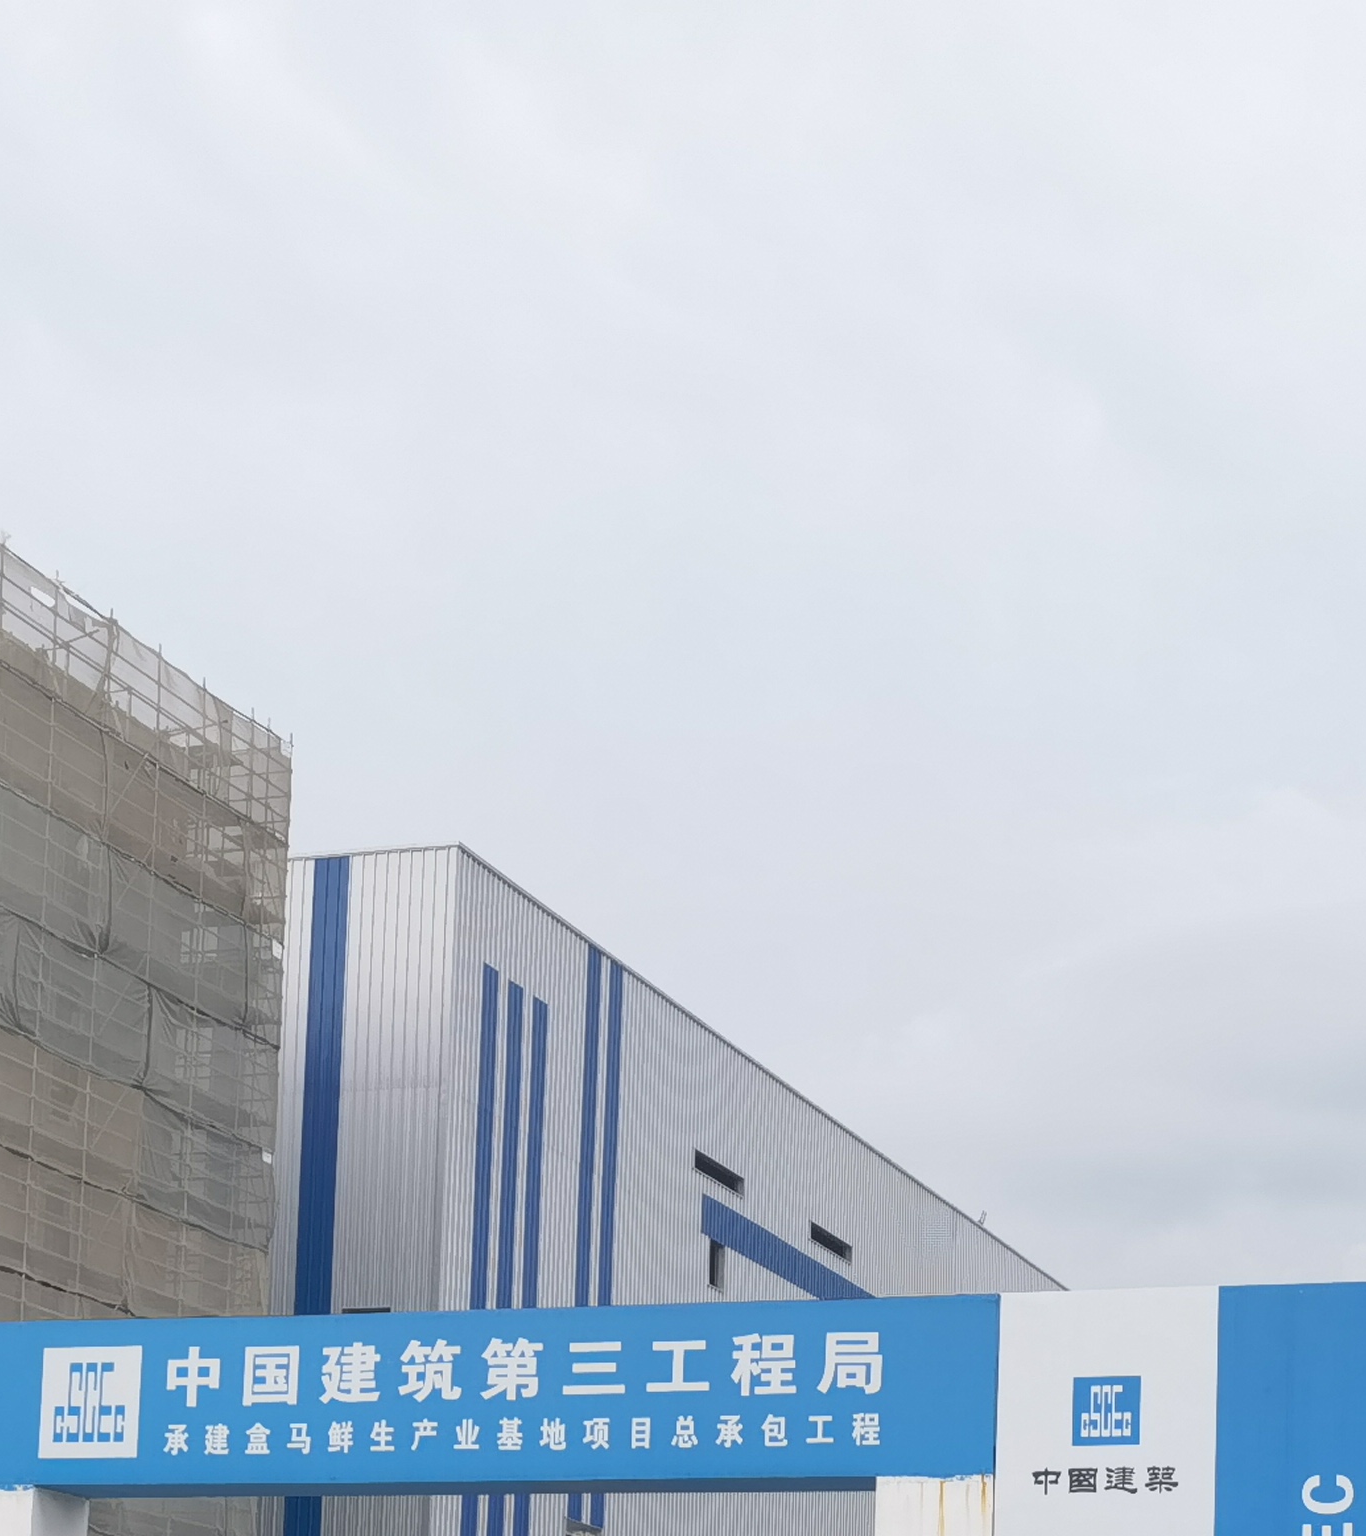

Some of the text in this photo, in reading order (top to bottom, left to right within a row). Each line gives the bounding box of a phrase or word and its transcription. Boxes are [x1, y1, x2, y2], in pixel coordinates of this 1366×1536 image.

[165, 1331, 883, 1408] 中国建筑第三工程局
[163, 1411, 881, 1456] 承建盒马鲜生产业基地项目总承包工程
